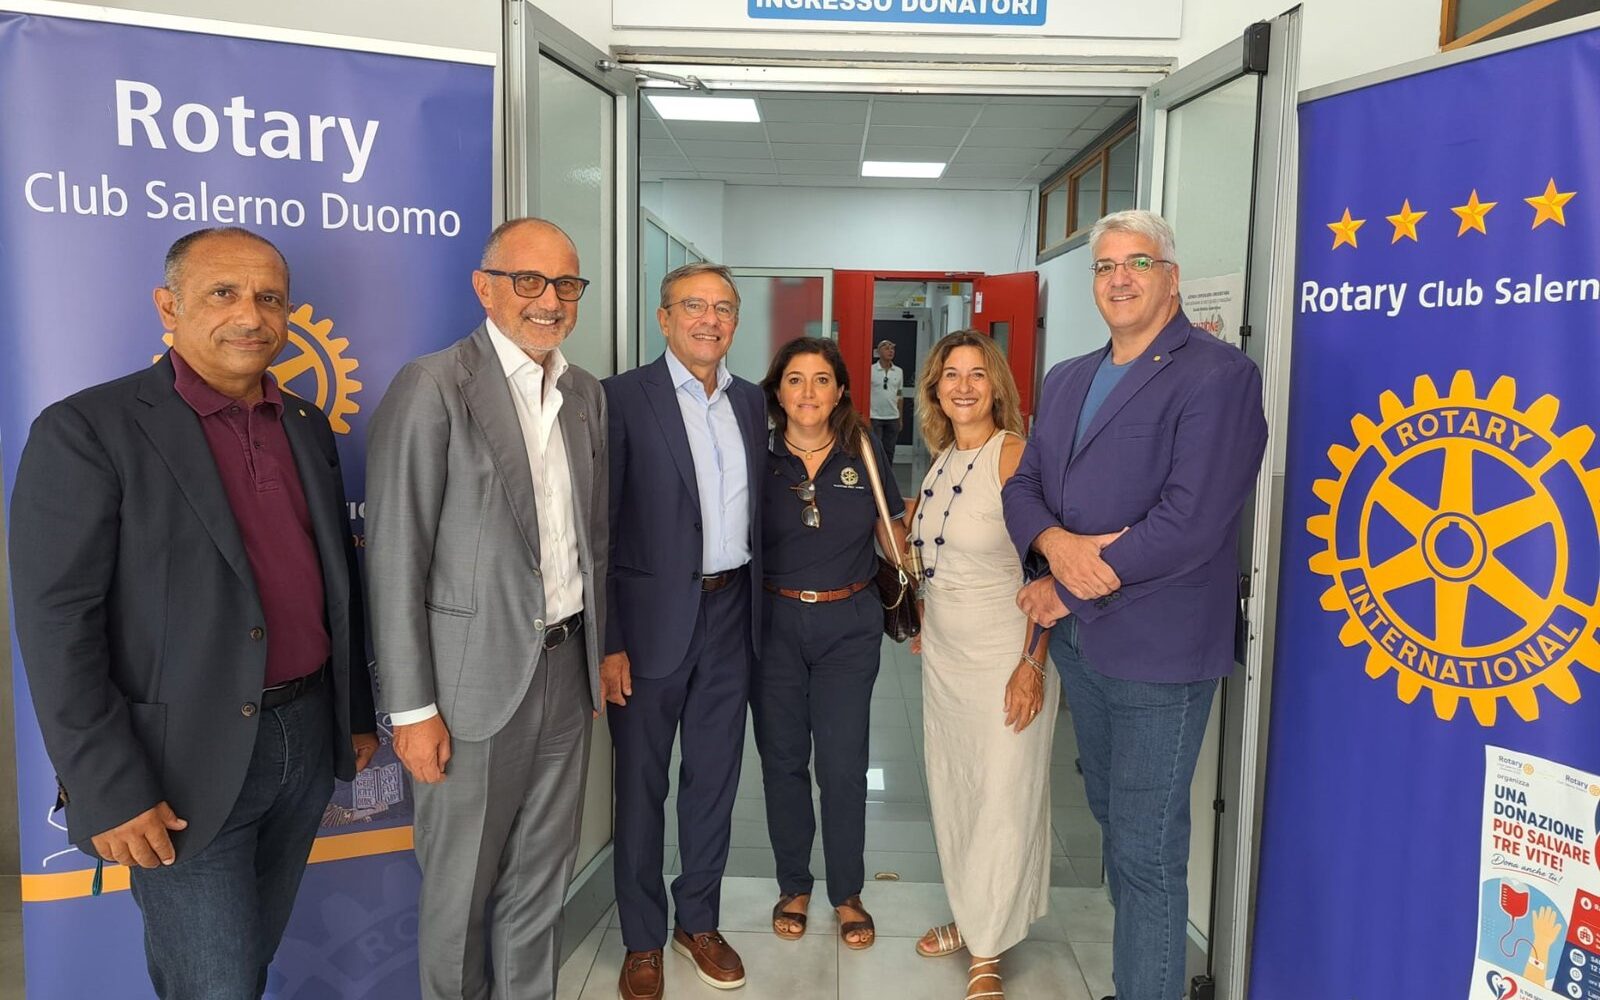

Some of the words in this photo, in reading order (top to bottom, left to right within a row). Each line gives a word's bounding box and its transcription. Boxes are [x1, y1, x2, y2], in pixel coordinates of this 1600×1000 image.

[901, 0, 1039, 15] DONATORI
[115, 79, 380, 183] Rotary
[23, 171, 129, 217] Club
[145, 180, 306, 228] Salerno
[322, 191, 462, 238] Duomo
[1300, 280, 1408, 317] Rotary
[1418, 278, 1484, 309] Club
[1395, 409, 1534, 451] ROTARY
[1348, 583, 1580, 685] INTERNATIONAL
[1496, 774, 1530, 787] organizza
[1498, 755, 1523, 768] Rotary
[1495, 784, 1527, 806] UNA
[1565, 774, 1589, 789] Rotary
[1494, 801, 1584, 843] DONAZIONE
[1493, 818, 1524, 839] PUÒ
[1527, 828, 1591, 866] SALVARE
[1493, 835, 1520, 856] TRE
[1525, 845, 1564, 873] VITE!
[1491, 853, 1519, 867] Dona
[1520, 865, 1547, 877] anche
